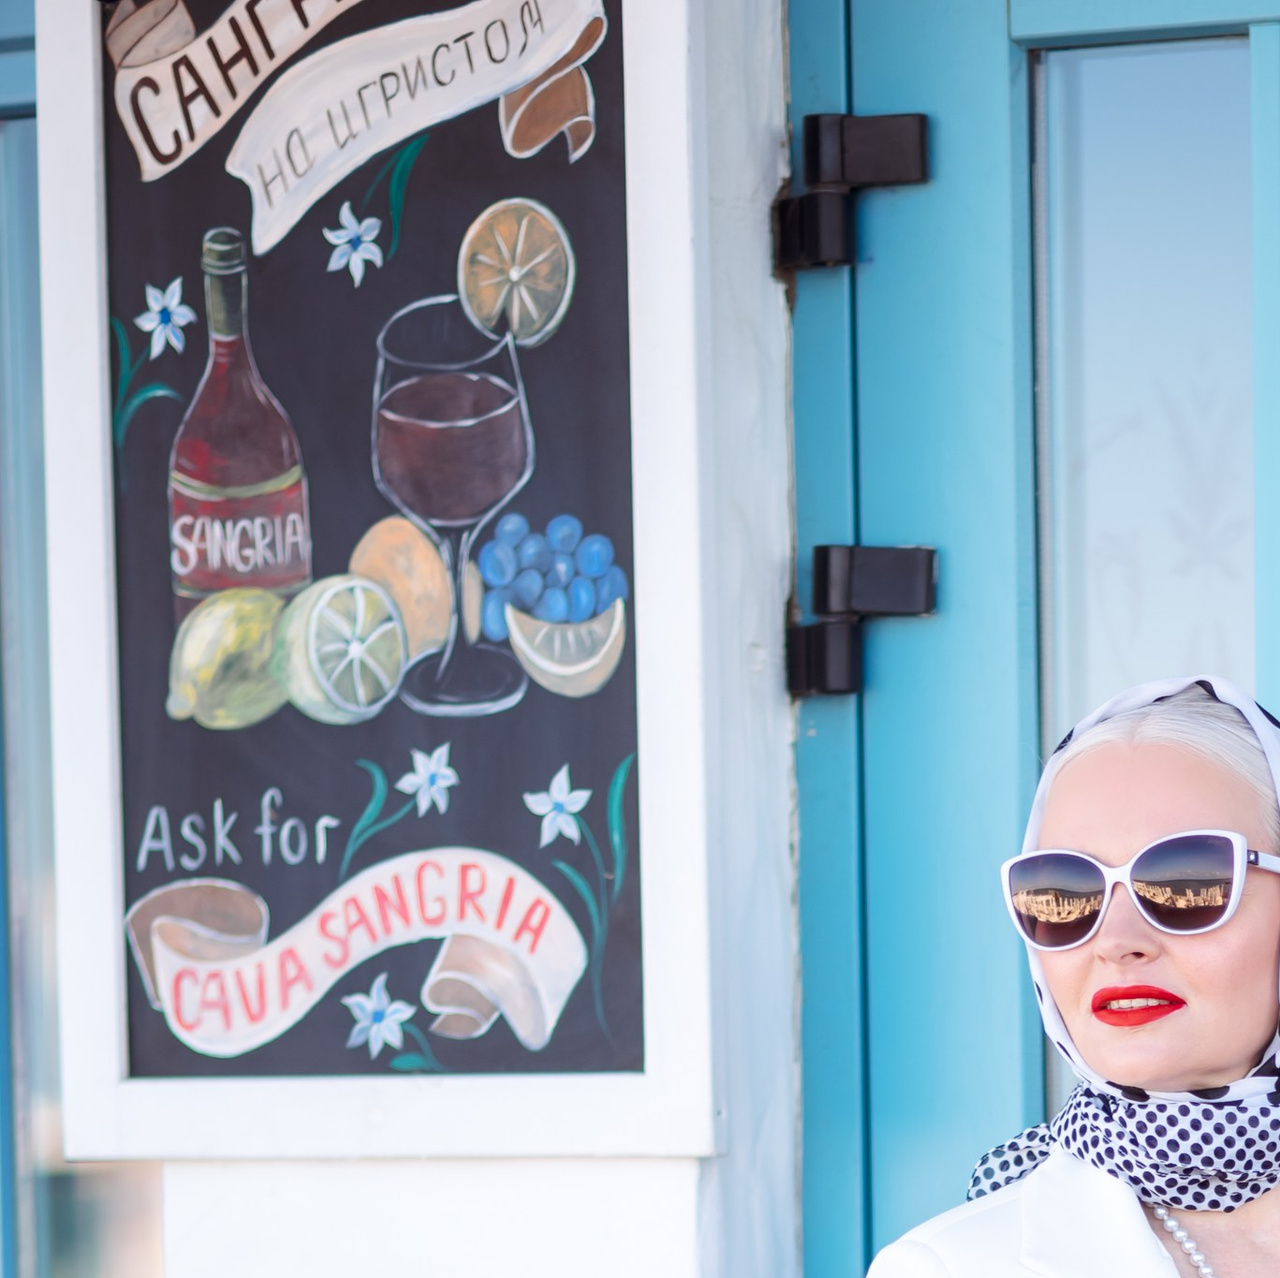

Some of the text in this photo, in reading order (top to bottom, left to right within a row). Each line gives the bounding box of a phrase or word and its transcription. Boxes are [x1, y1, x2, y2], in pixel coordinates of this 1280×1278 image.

[129, 0, 342, 165] САНГ
[170, 512, 306, 576] SANGRIA
[136, 786, 341, 872] Ask for
[172, 860, 552, 1033] CAVA SANGRIA
